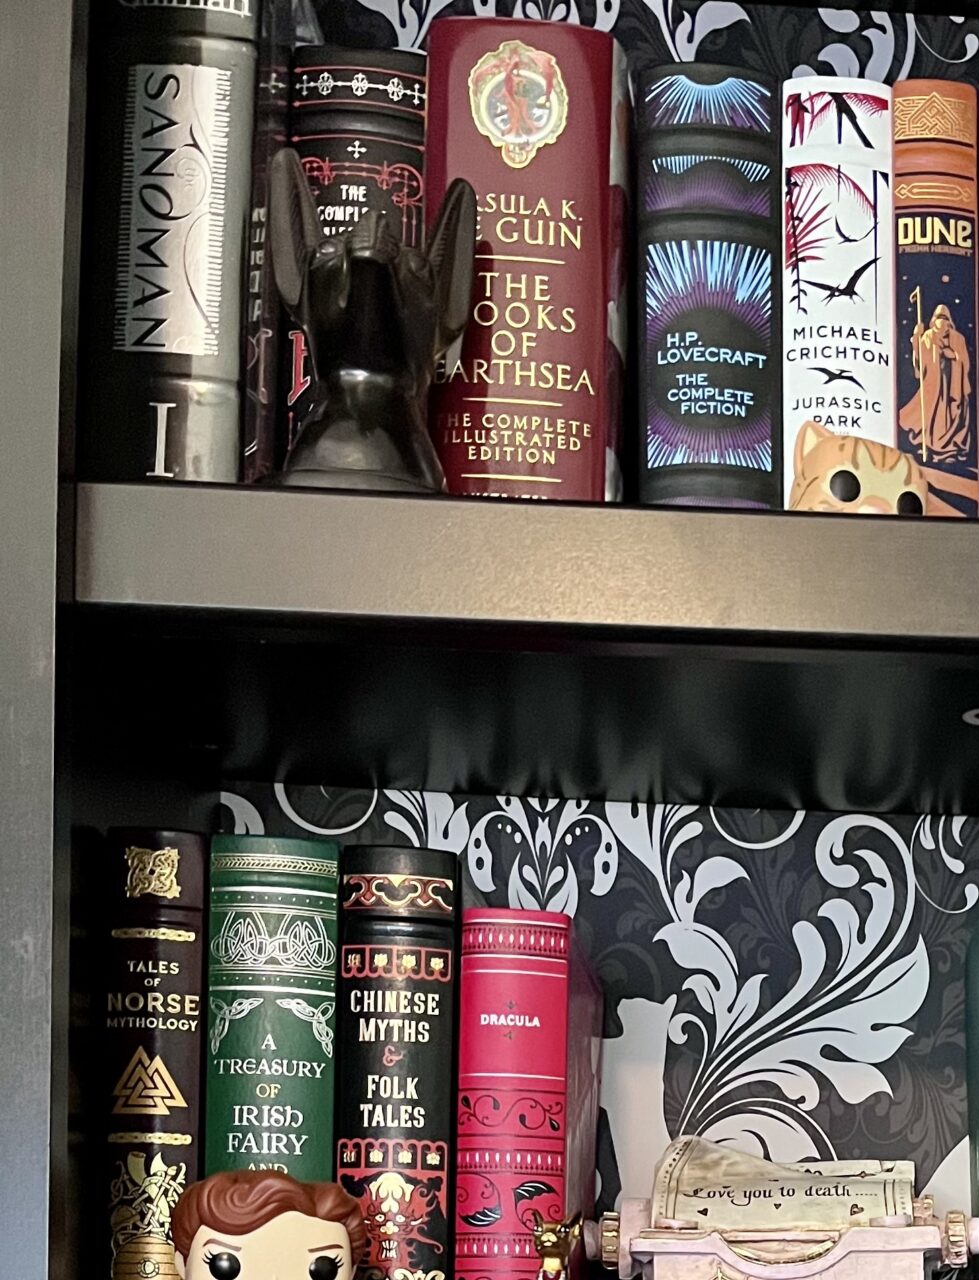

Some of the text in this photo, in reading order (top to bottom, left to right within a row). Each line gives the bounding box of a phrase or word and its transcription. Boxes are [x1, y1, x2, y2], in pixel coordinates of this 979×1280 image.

[340, 184, 366, 202] THE
[478, 272, 551, 301] THE
[491, 330, 537, 357] OF
[666, 331, 703, 347] H.P.
[793, 326, 884, 345] MICHAEL
[657, 347, 767, 369] LOVECRAFT
[786, 346, 890, 367] CRICHTON
[676, 374, 708, 386] THE
[668, 389, 754, 405] COMPLETE
[792, 396, 882, 414] JURASSIC
[681, 402, 746, 417] FICTION
[481, 413, 592, 438] COMPLETE
[813, 415, 862, 429] PARK
[146, 402, 176, 477] I
[444, 430, 581, 452] ILLUSTRATED
[468, 446, 556, 465] EDITION
[127, 960, 180, 975] TALES
[144, 977, 161, 987] OF
[107, 992, 200, 1016] NORSE
[350, 990, 439, 1015] CHINESE
[106, 1017, 199, 1031] MYTHOLOGY
[359, 1018, 430, 1043] MYTHS
[480, 1014, 541, 1027] DRACULA
[261, 1033, 277, 1050] A
[383, 1045, 404, 1067] &
[214, 1058, 325, 1079] TREASURY
[256, 1083, 281, 1098] OF
[367, 1074, 419, 1100] FOLK
[360, 1103, 426, 1128] TALES
[227, 1132, 309, 1156] FAIRY
[683, 1184, 795, 1206] Love you to
